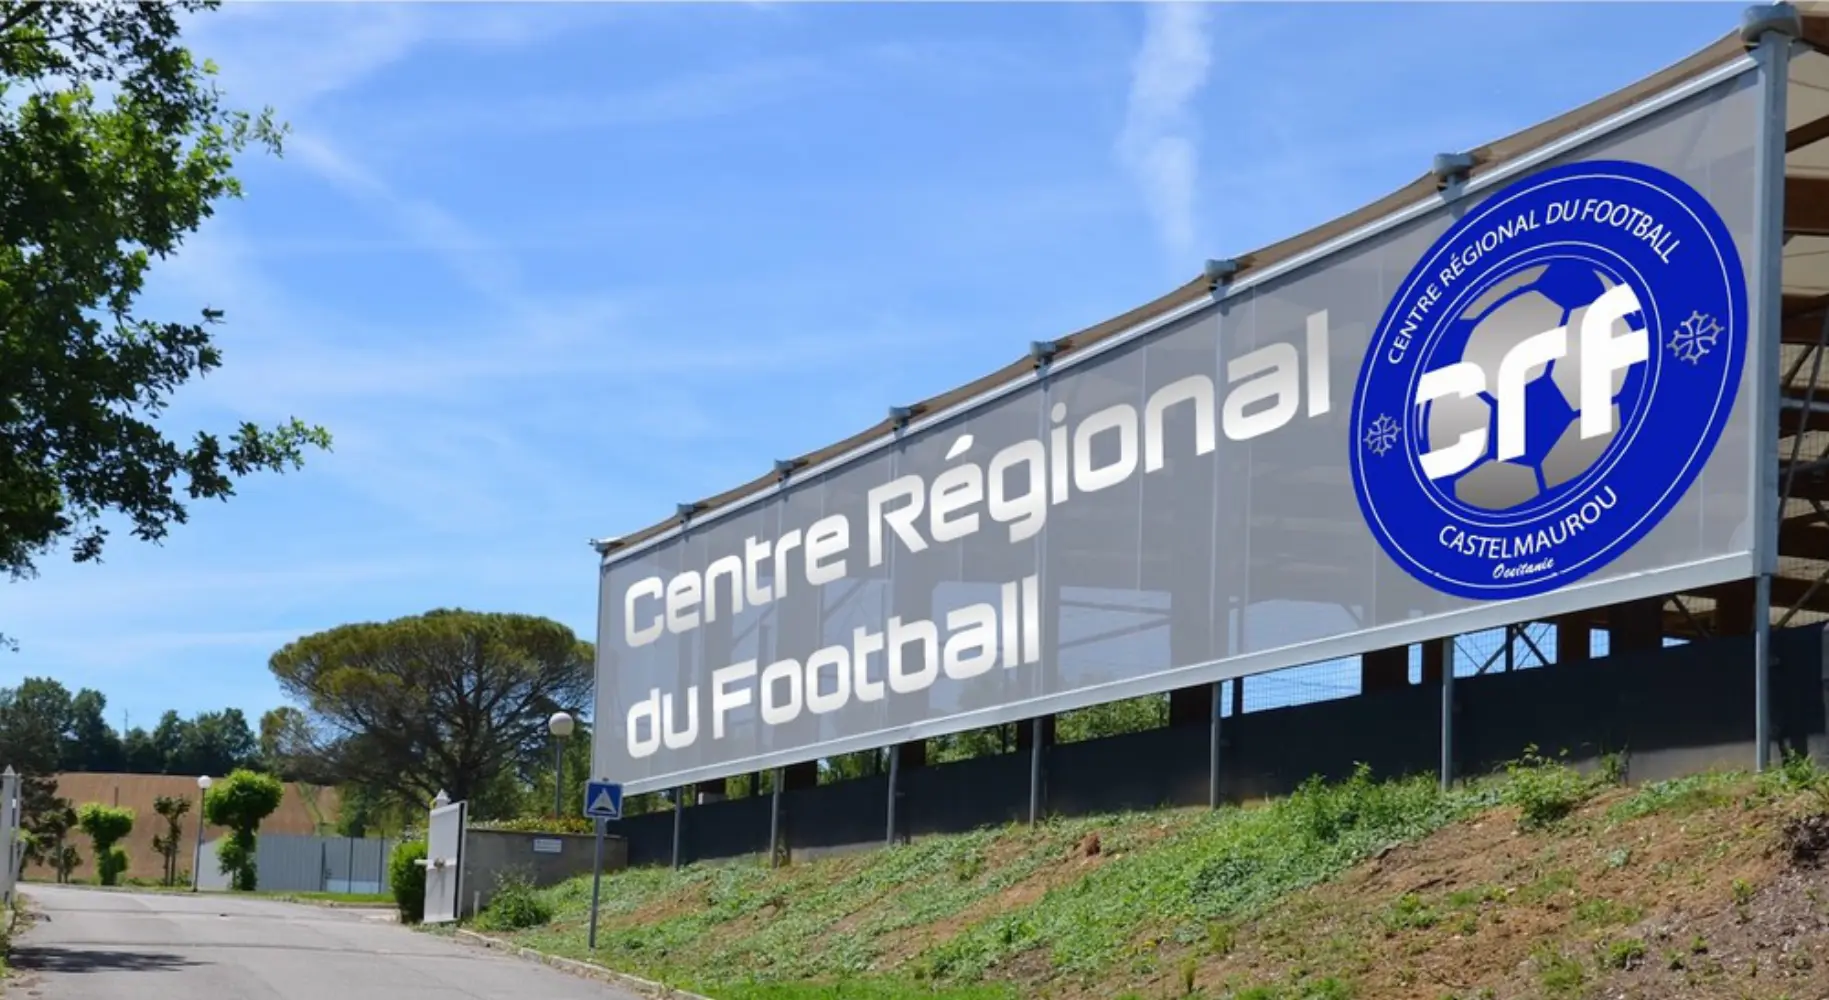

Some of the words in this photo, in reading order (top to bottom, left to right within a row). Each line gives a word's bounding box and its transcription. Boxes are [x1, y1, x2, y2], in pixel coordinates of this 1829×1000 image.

[1388, 284, 1442, 365] CENTRE
[1438, 209, 1540, 288] RÉGIONAL
[1545, 199, 1579, 226] DU
[1580, 198, 1681, 265] FOOTBALL
[624, 513, 851, 649] Centre
[866, 308, 1331, 568] Régional
[1438, 485, 1618, 559] CASTELMAUROU
[626, 685, 699, 760] du
[712, 573, 1041, 740] Football
